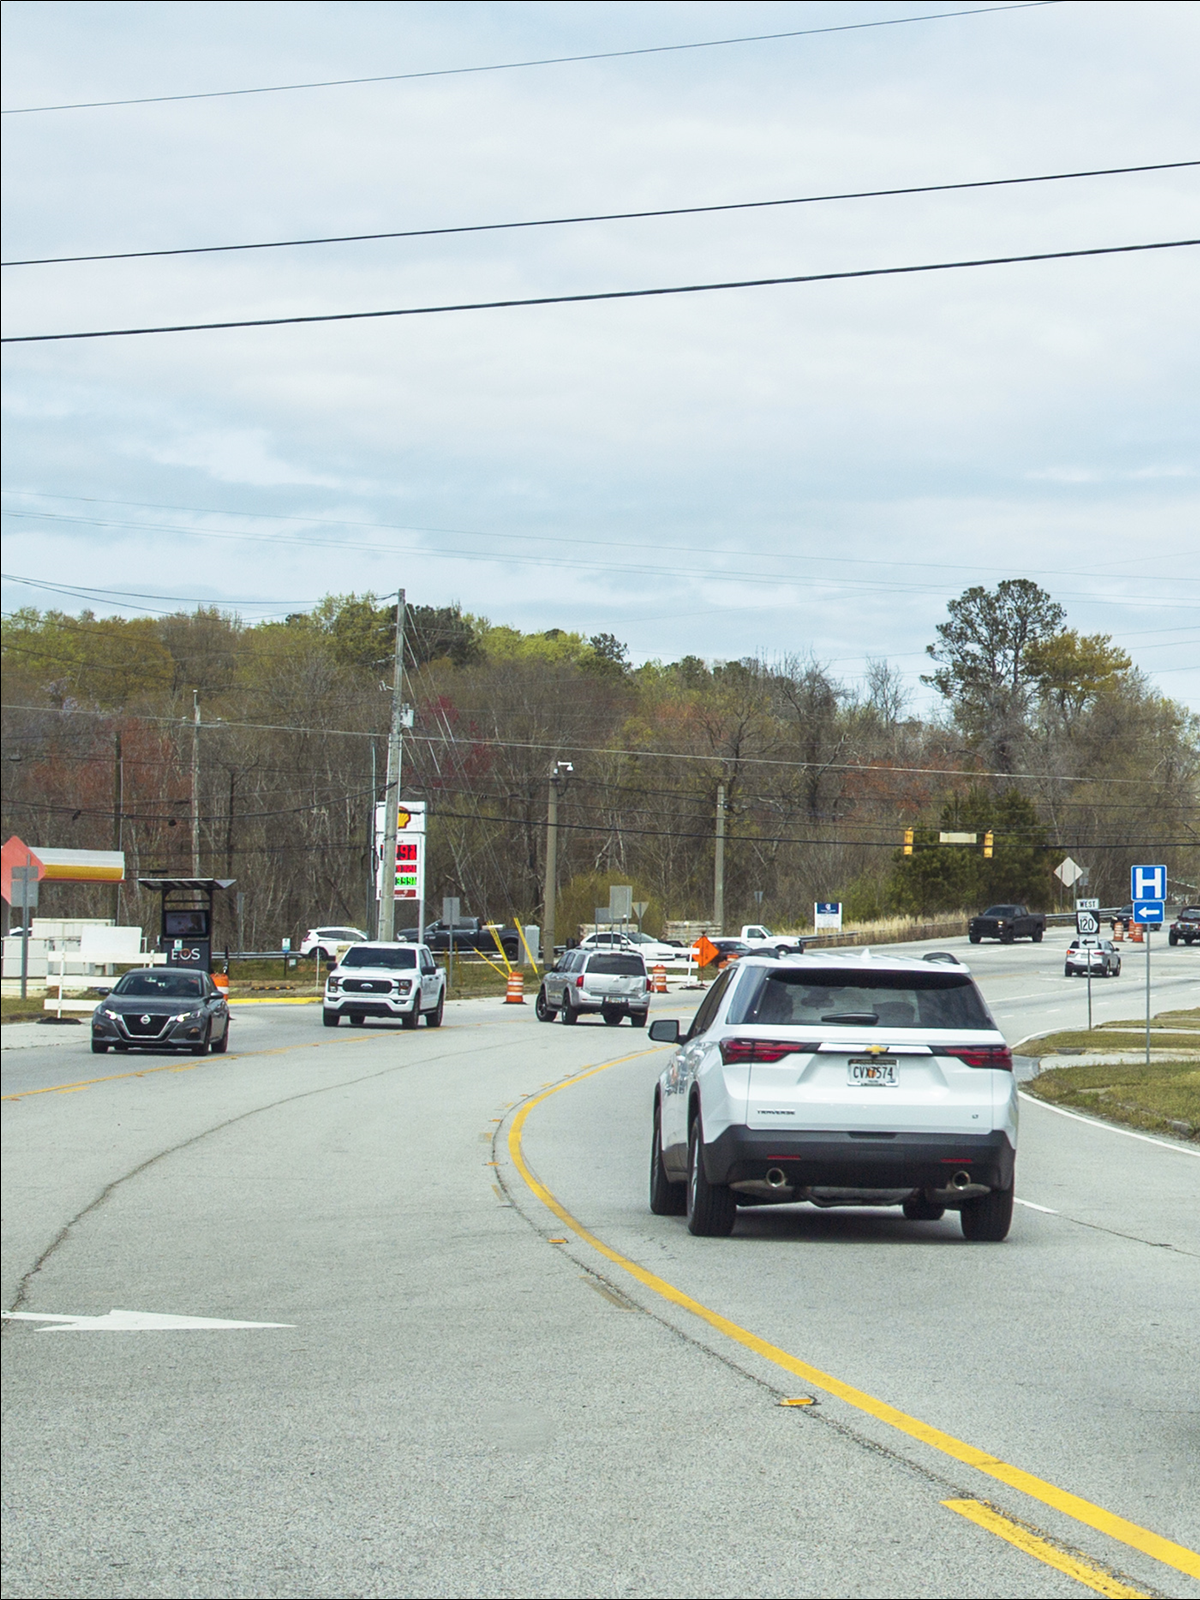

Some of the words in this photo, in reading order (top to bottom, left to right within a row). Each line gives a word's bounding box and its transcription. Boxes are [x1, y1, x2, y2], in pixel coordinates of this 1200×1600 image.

[1136, 868, 1162, 898] H
[1079, 900, 1096, 908] WEST
[1080, 918, 1095, 931] 120
[171, 948, 201, 960] EOS
